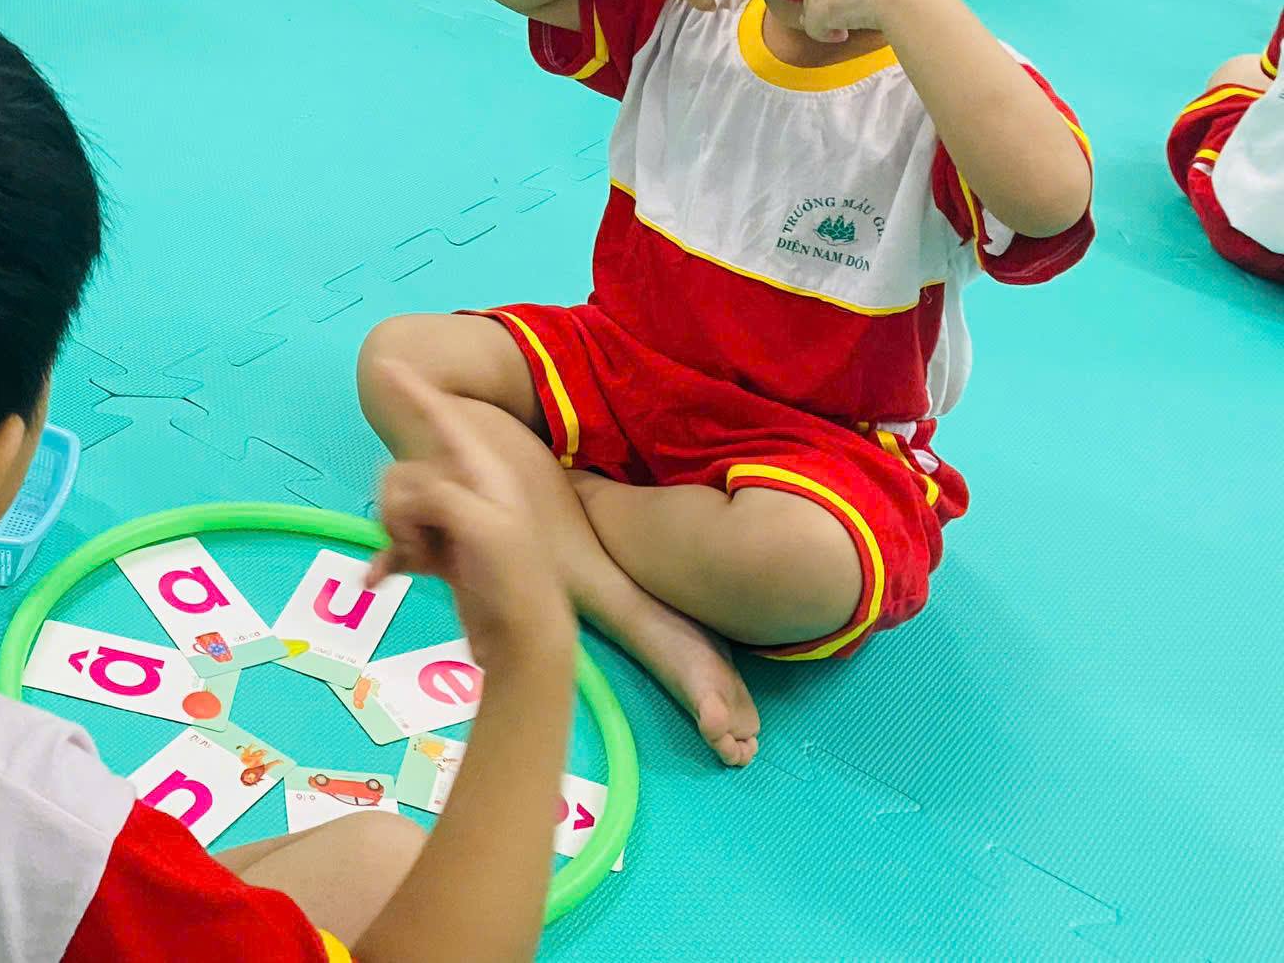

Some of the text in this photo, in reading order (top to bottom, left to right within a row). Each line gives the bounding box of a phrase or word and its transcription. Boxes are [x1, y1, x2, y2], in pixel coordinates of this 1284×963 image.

[812, 247, 843, 264] NAM
[157, 564, 231, 615] a
[313, 577, 377, 630] u
[67, 645, 165, 697] â
[417, 659, 485, 706] e
